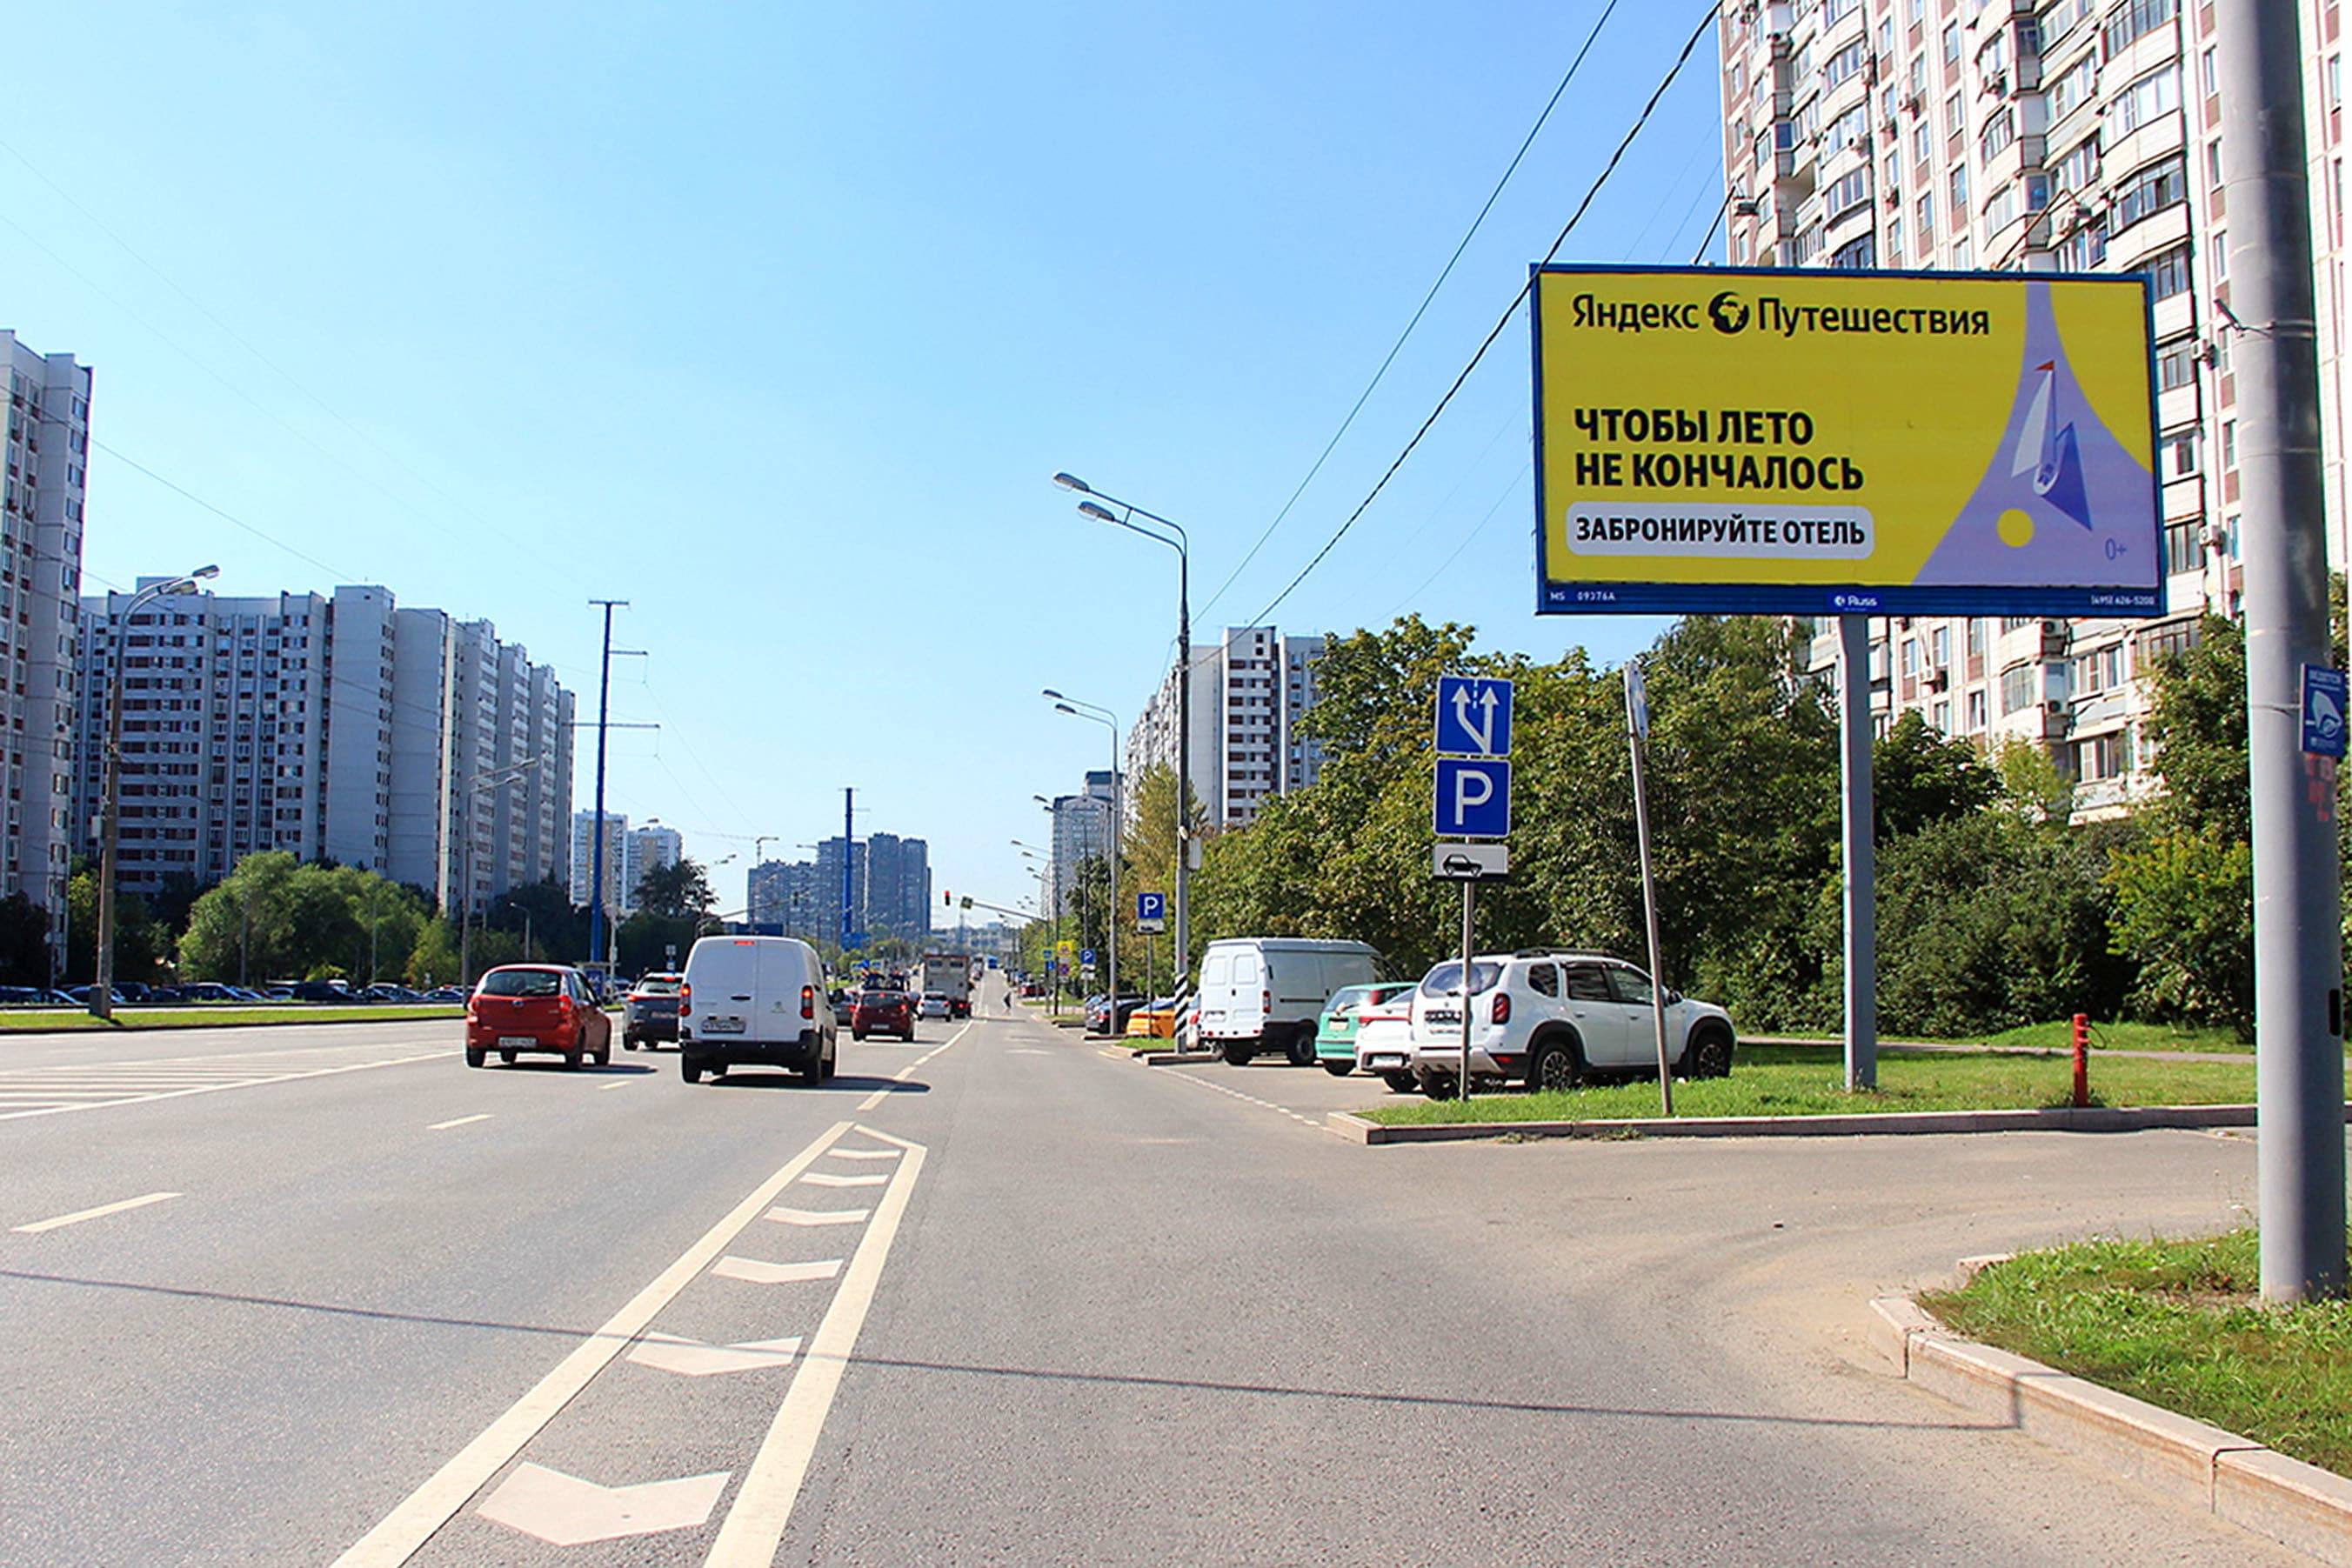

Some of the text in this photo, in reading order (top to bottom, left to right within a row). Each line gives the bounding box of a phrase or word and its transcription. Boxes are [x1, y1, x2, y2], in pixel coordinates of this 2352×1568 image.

[1573, 294, 1989, 337] Яндекс Путешествия
[1574, 408, 1814, 445] ЧТОБЫ ЛЕТО
[1575, 452, 1864, 490] НЕ КОНЧАЛОСЬ
[1576, 513, 1866, 544] ЗАБРОНИРУЙТЕ ОТЕЛЬ
[2105, 537, 2127, 560] 0+
[1454, 769, 1493, 825] P
